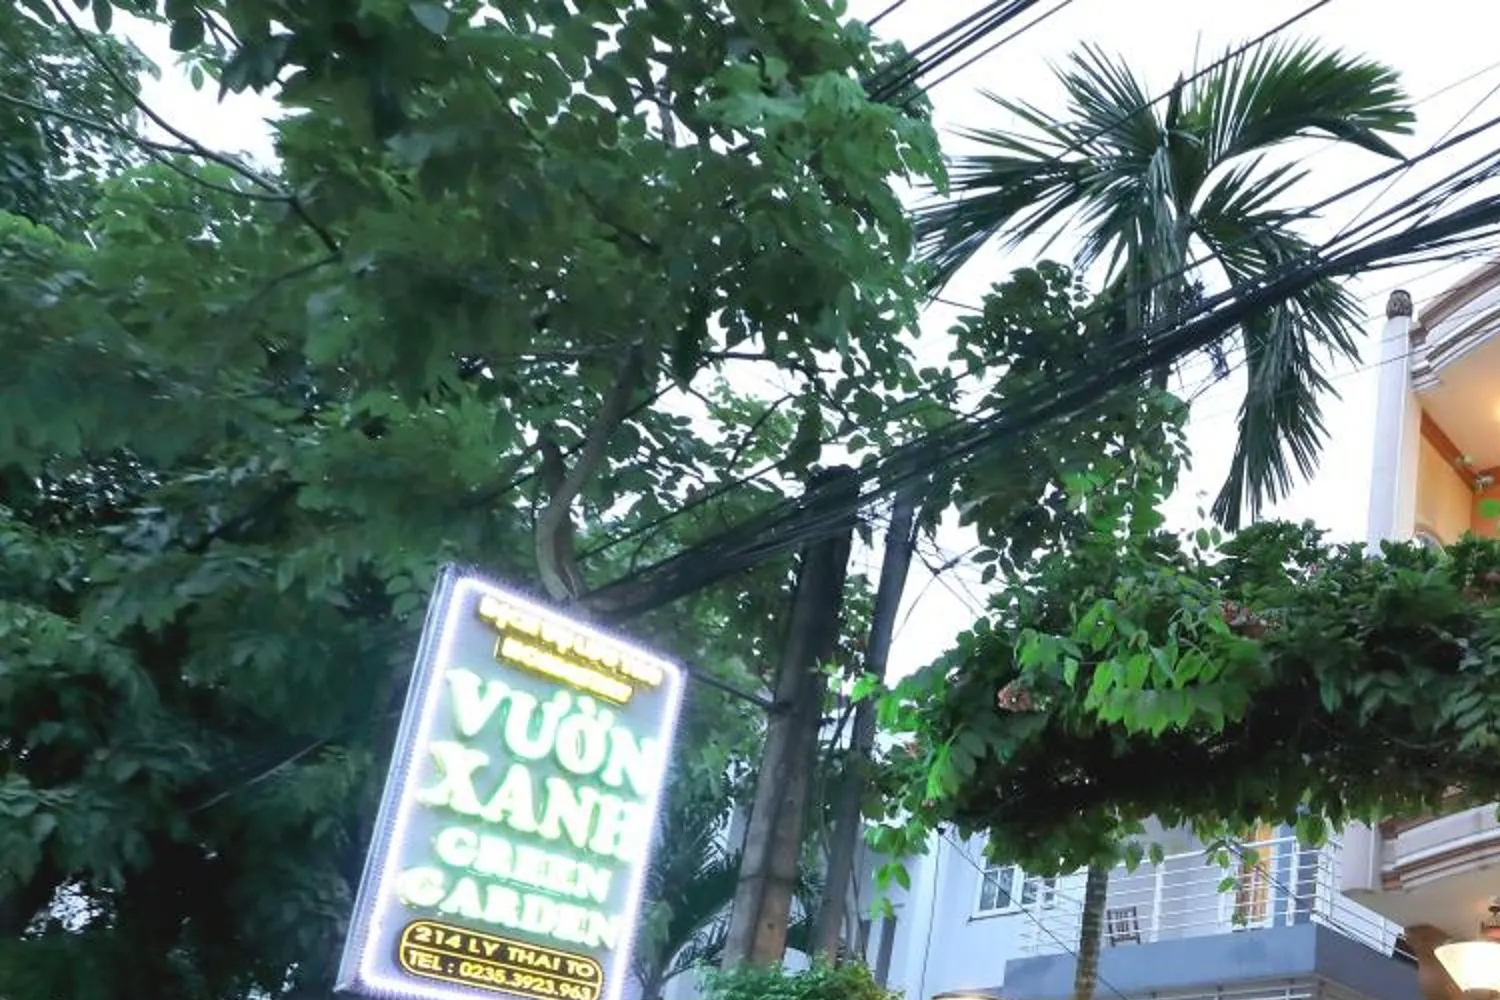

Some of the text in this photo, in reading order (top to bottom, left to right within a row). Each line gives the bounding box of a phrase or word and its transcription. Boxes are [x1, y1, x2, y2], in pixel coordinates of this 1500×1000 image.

[445, 667, 664, 796] VƯỜN
[413, 741, 651, 862] XANH
[400, 865, 624, 949] GARDEN
[414, 926, 595, 977] 214 LY THAI TO
